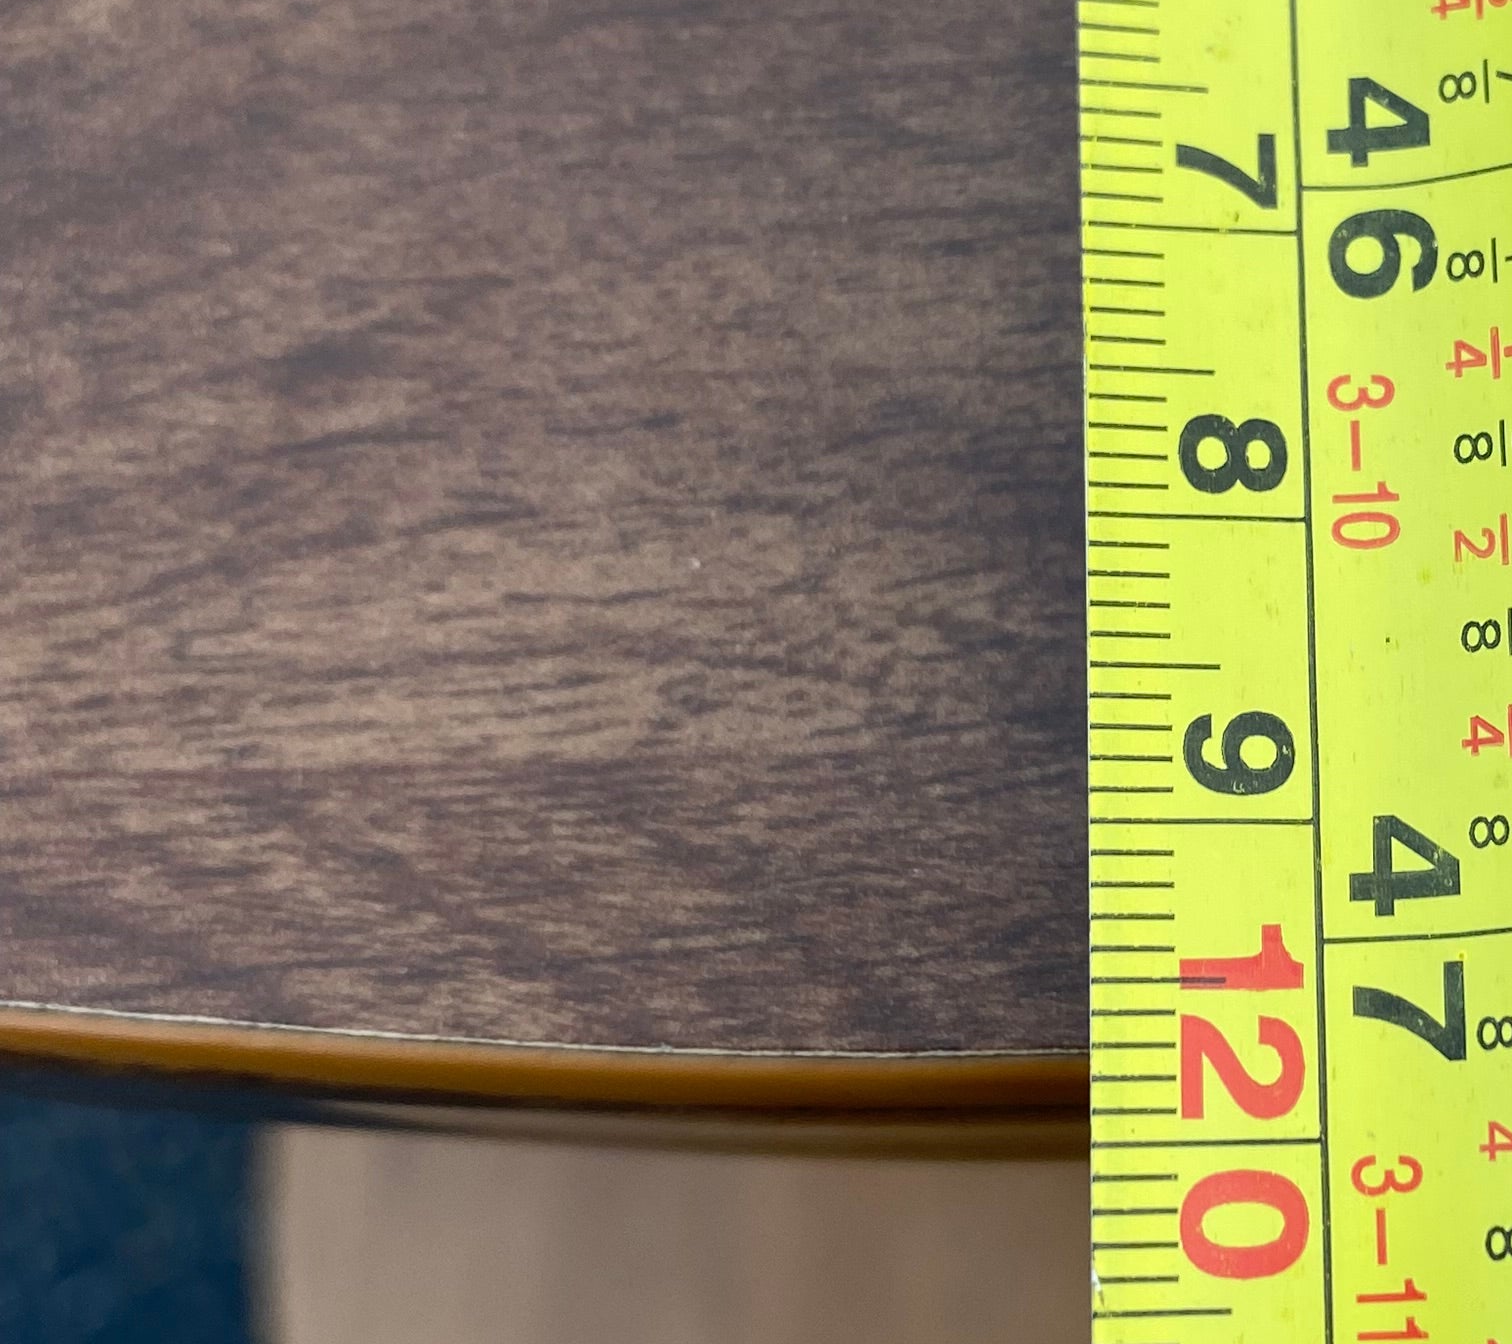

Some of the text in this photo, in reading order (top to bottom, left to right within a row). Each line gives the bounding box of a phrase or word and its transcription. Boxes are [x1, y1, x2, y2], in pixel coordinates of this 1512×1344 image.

[1175, 133, 1278, 210] 7
[1177, 413, 1288, 494] 8
[1327, 374, 1401, 549] 3-10
[1183, 710, 1296, 796] 9
[1179, 924, 1310, 1280] 120
[1351, 1155, 1429, 1341] 3-11
